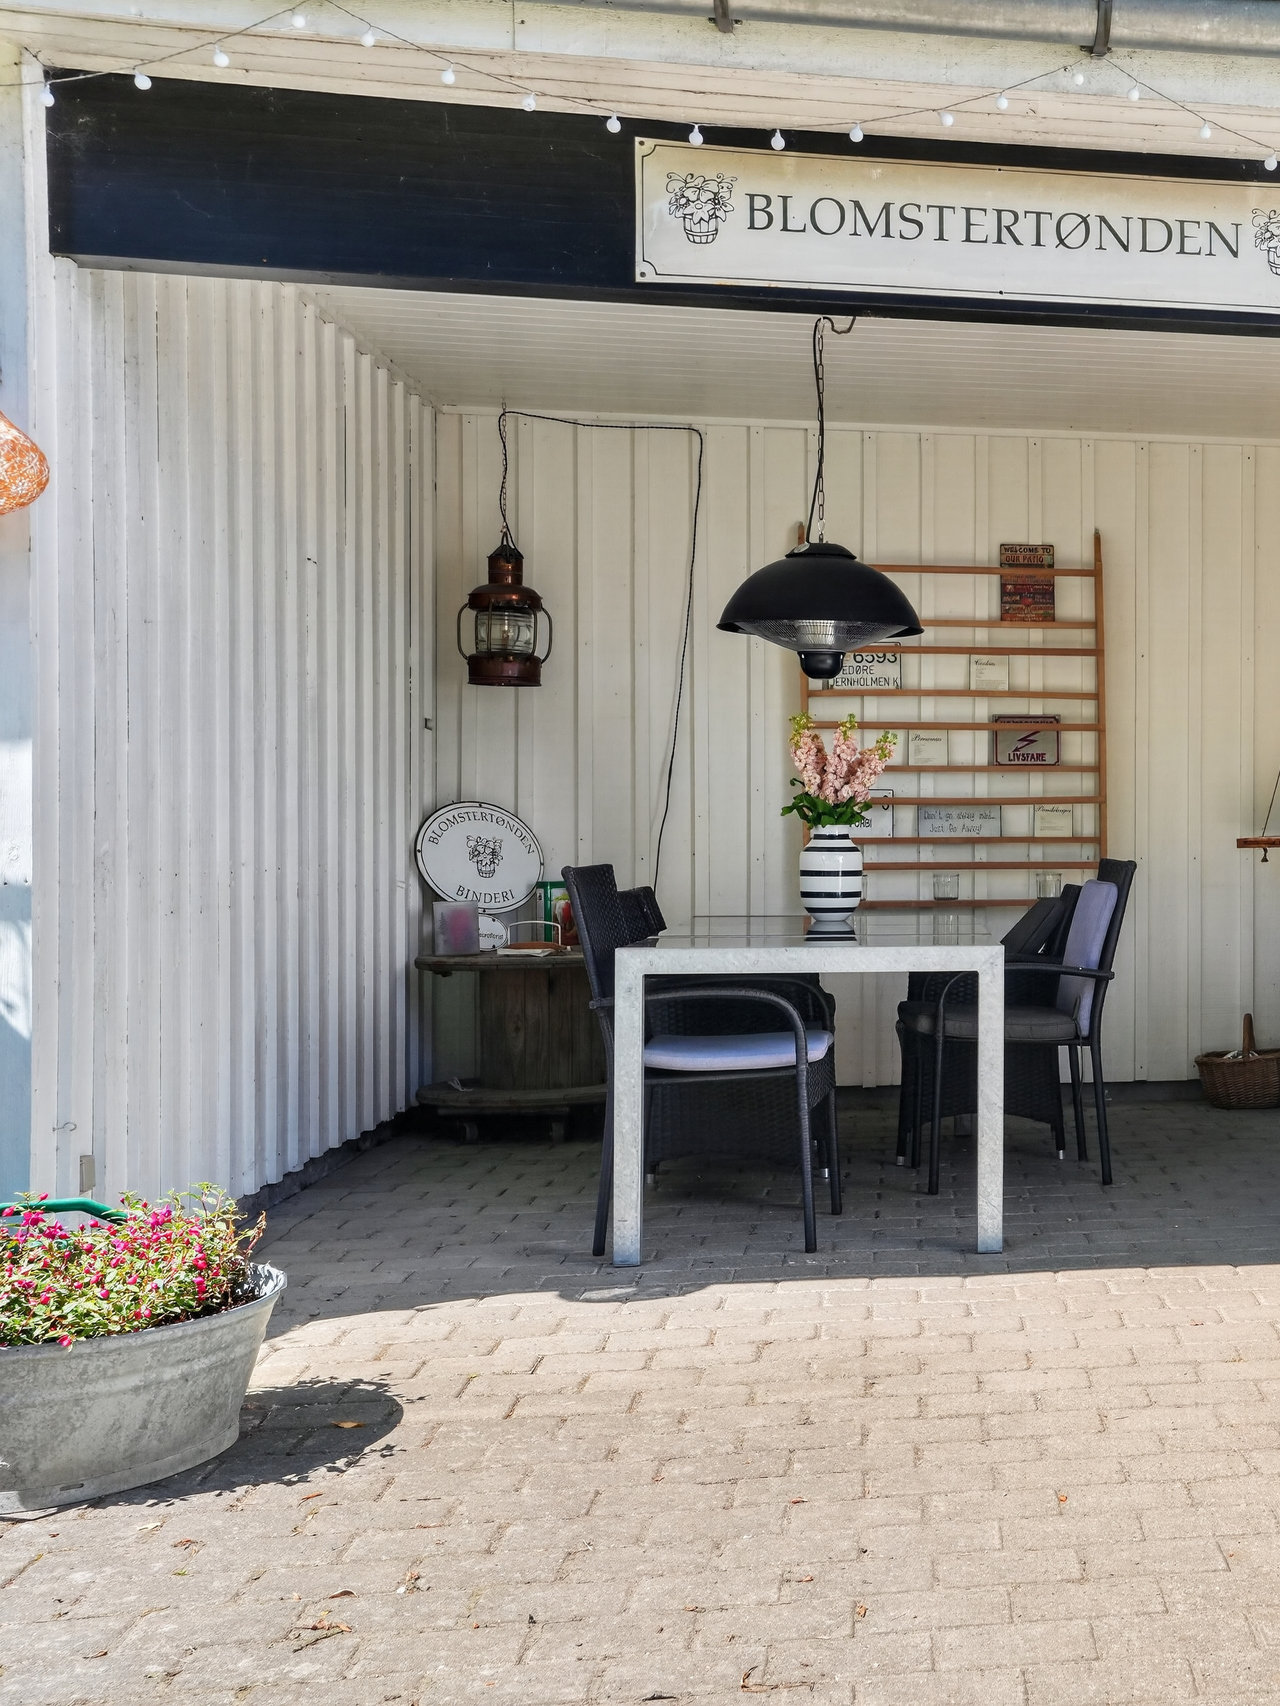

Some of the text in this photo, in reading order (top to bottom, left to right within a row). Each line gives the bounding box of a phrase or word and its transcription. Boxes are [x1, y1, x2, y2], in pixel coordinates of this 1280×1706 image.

[745, 193, 1242, 259] BLOMSTERTØNDEN
[1003, 546, 1039, 554] WELCOME
[1005, 555, 1044, 563] OUR PATIO
[1008, 752, 1047, 762] LIVSFARE
[428, 810, 535, 855] BLOMSTERTØNDEN
[456, 885, 515, 904] BINDERI
